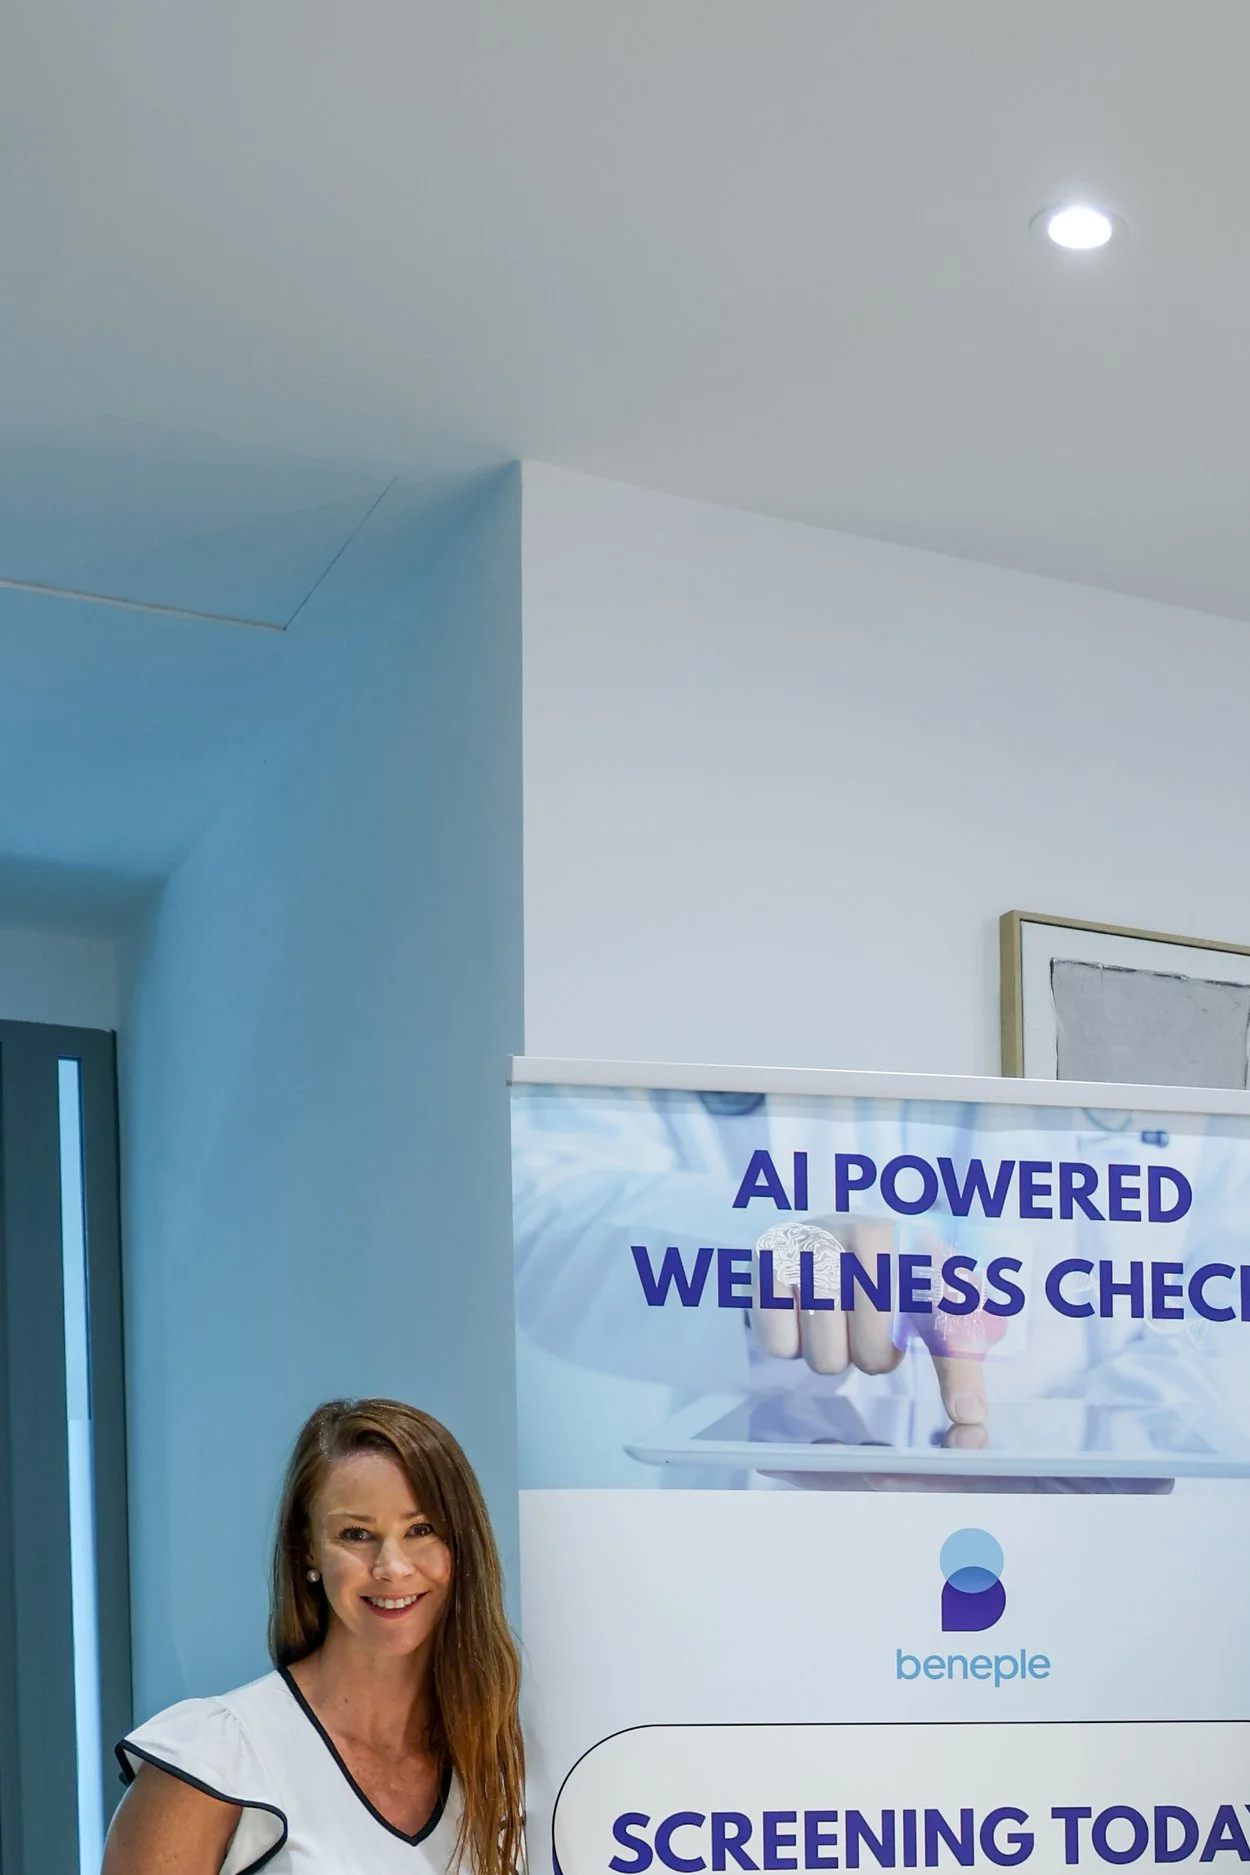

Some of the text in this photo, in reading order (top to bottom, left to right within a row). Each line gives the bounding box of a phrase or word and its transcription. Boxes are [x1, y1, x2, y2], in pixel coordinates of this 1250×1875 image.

[732, 1149, 1193, 1223] AI POWERED
[631, 1246, 1025, 1318] WELLNESS
[896, 1648, 1051, 1688] beneple
[608, 1806, 1035, 1874] SCREENING
